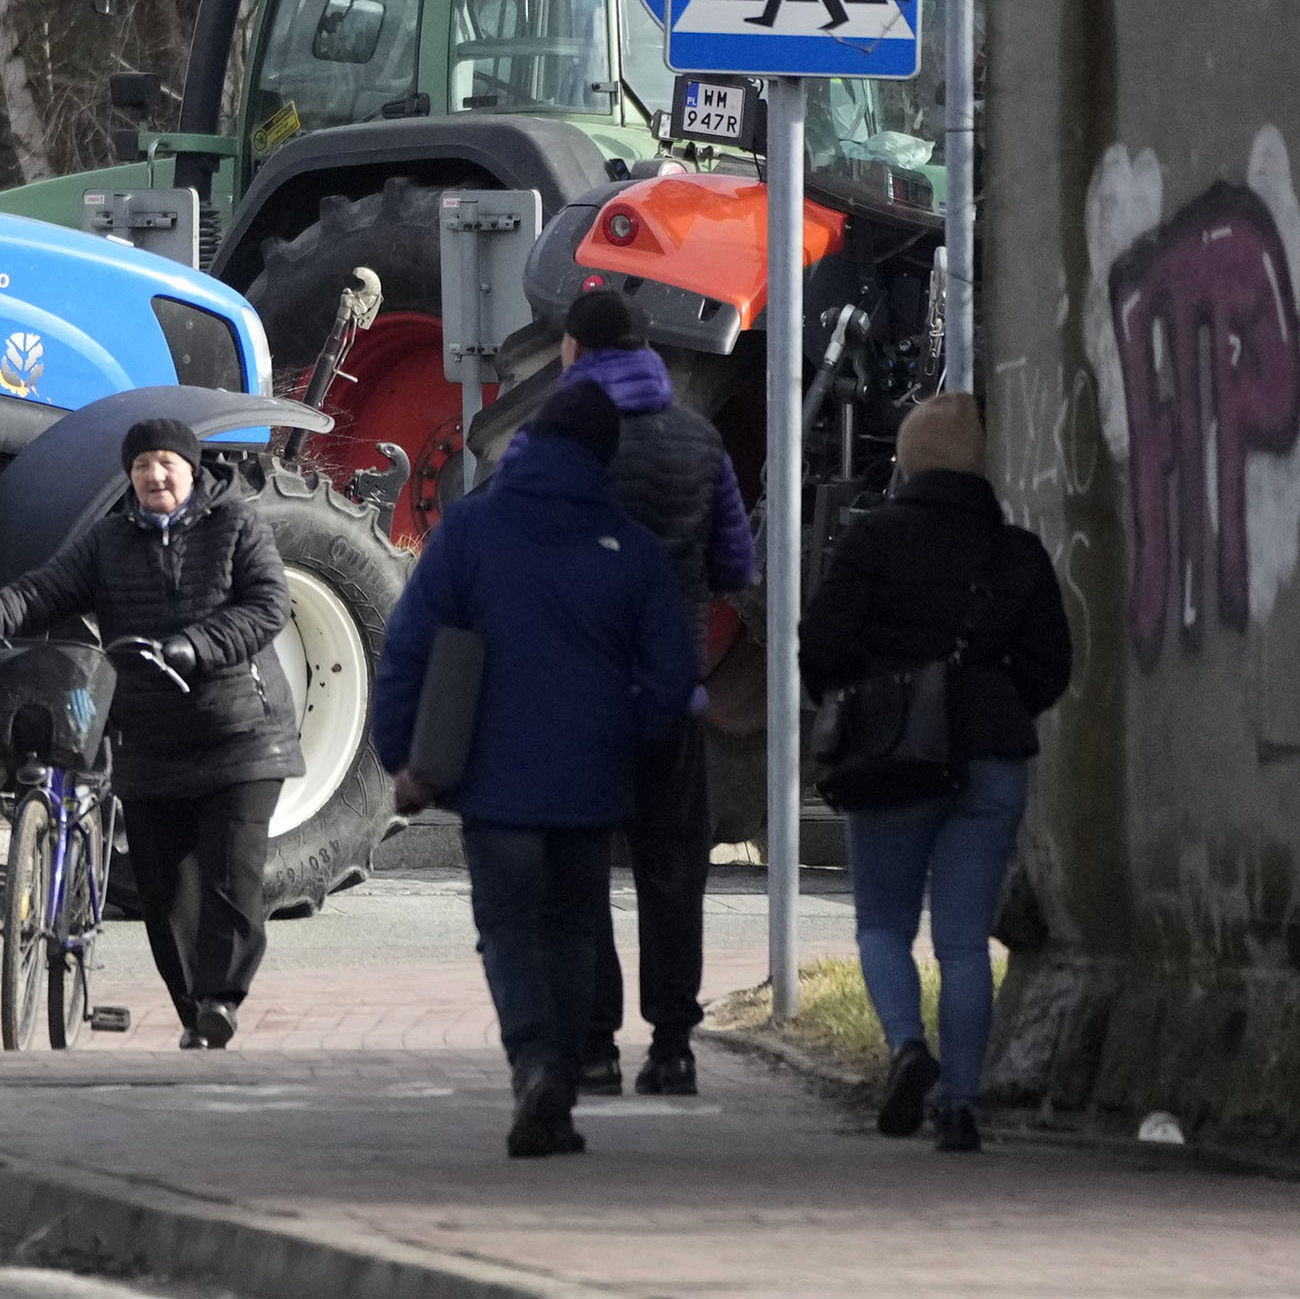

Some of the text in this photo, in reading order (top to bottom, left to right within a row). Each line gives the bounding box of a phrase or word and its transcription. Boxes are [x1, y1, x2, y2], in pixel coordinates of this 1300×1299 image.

[686, 96, 697, 106] PL
[704, 89, 727, 109] WM
[687, 110, 737, 133] 947R
